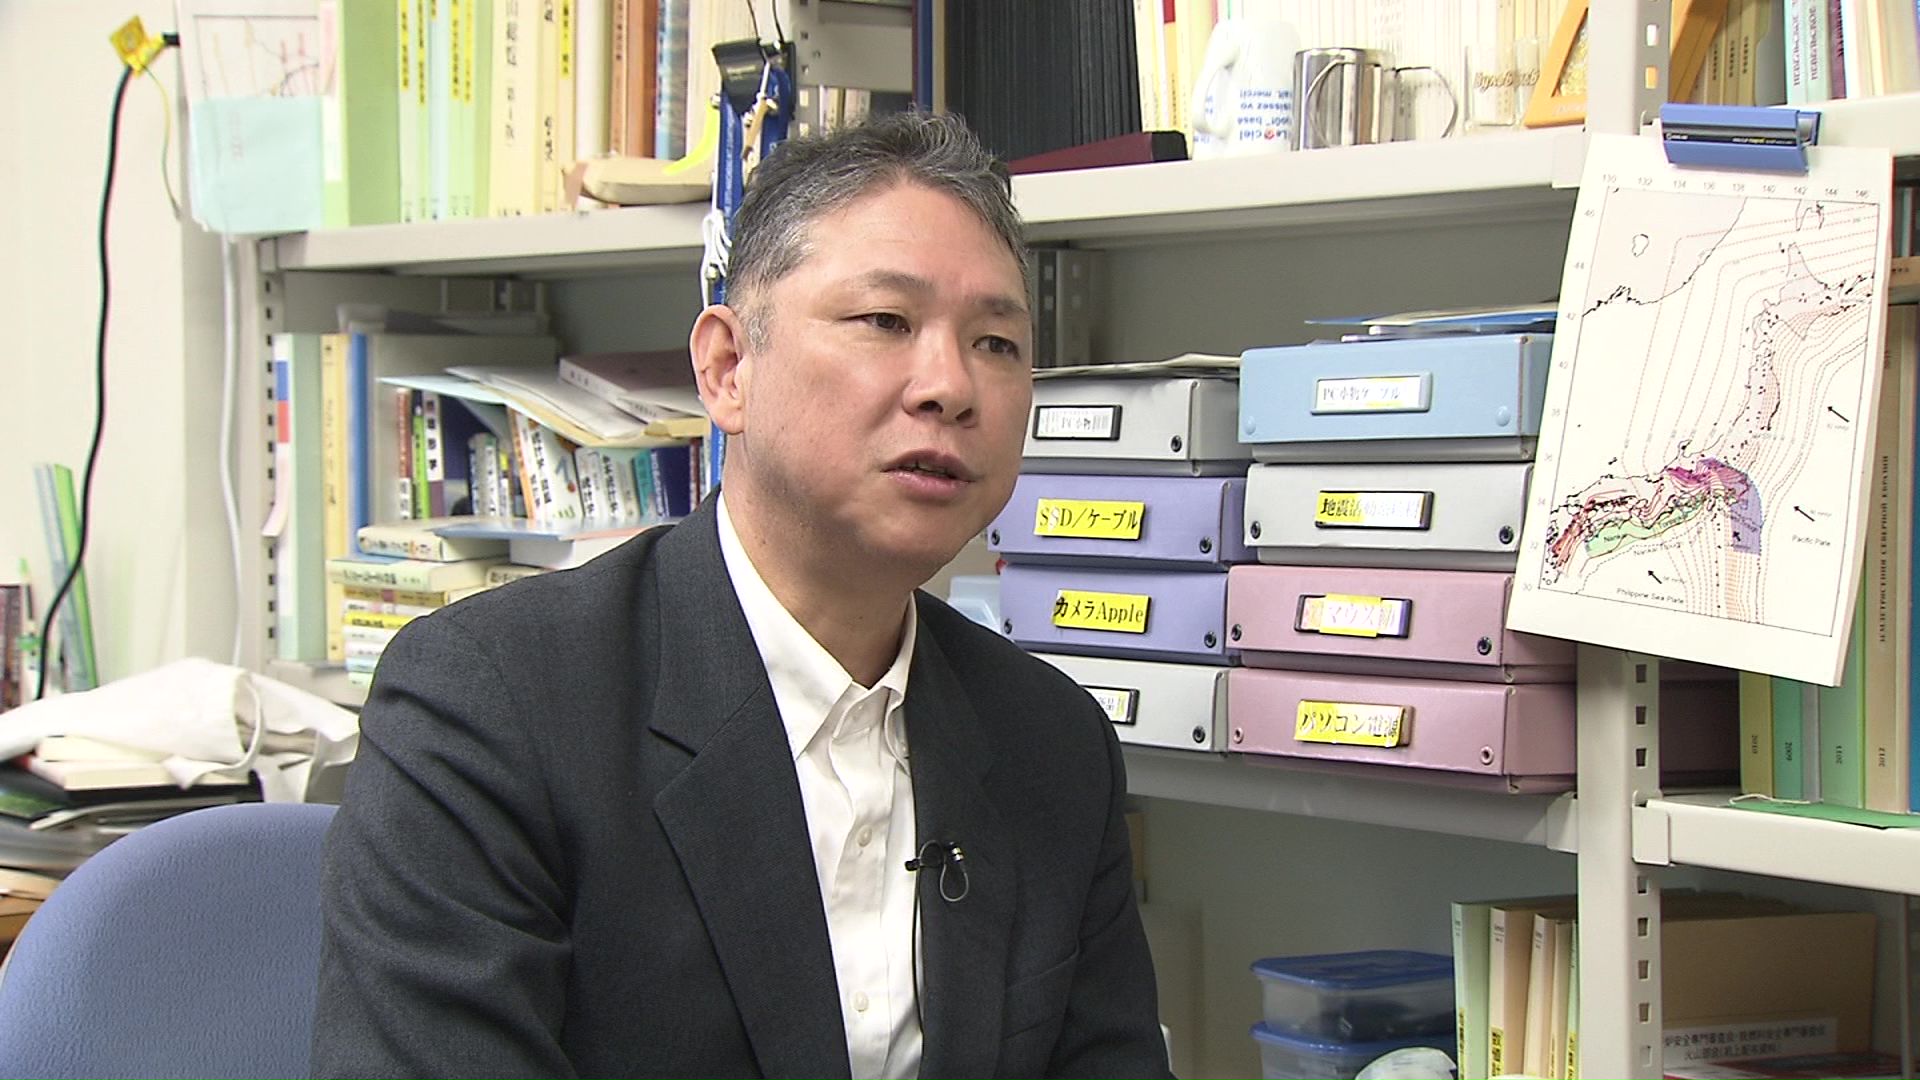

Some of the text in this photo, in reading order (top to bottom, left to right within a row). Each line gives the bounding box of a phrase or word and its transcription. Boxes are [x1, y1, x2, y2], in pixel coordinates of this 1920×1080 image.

[1239, 129, 1263, 141] ciel
[1637, 176, 1653, 187] 132
[1673, 179, 1687, 189] 134
[1762, 184, 1777, 194] 140
[1793, 185, 1808, 196] 142
[1824, 187, 1840, 197] 144
[1815, 537, 1832, 547] Plate
[1616, 587, 1685, 604] Philippine Sea Plate
[1053, 595, 1144, 624] カメラApple
